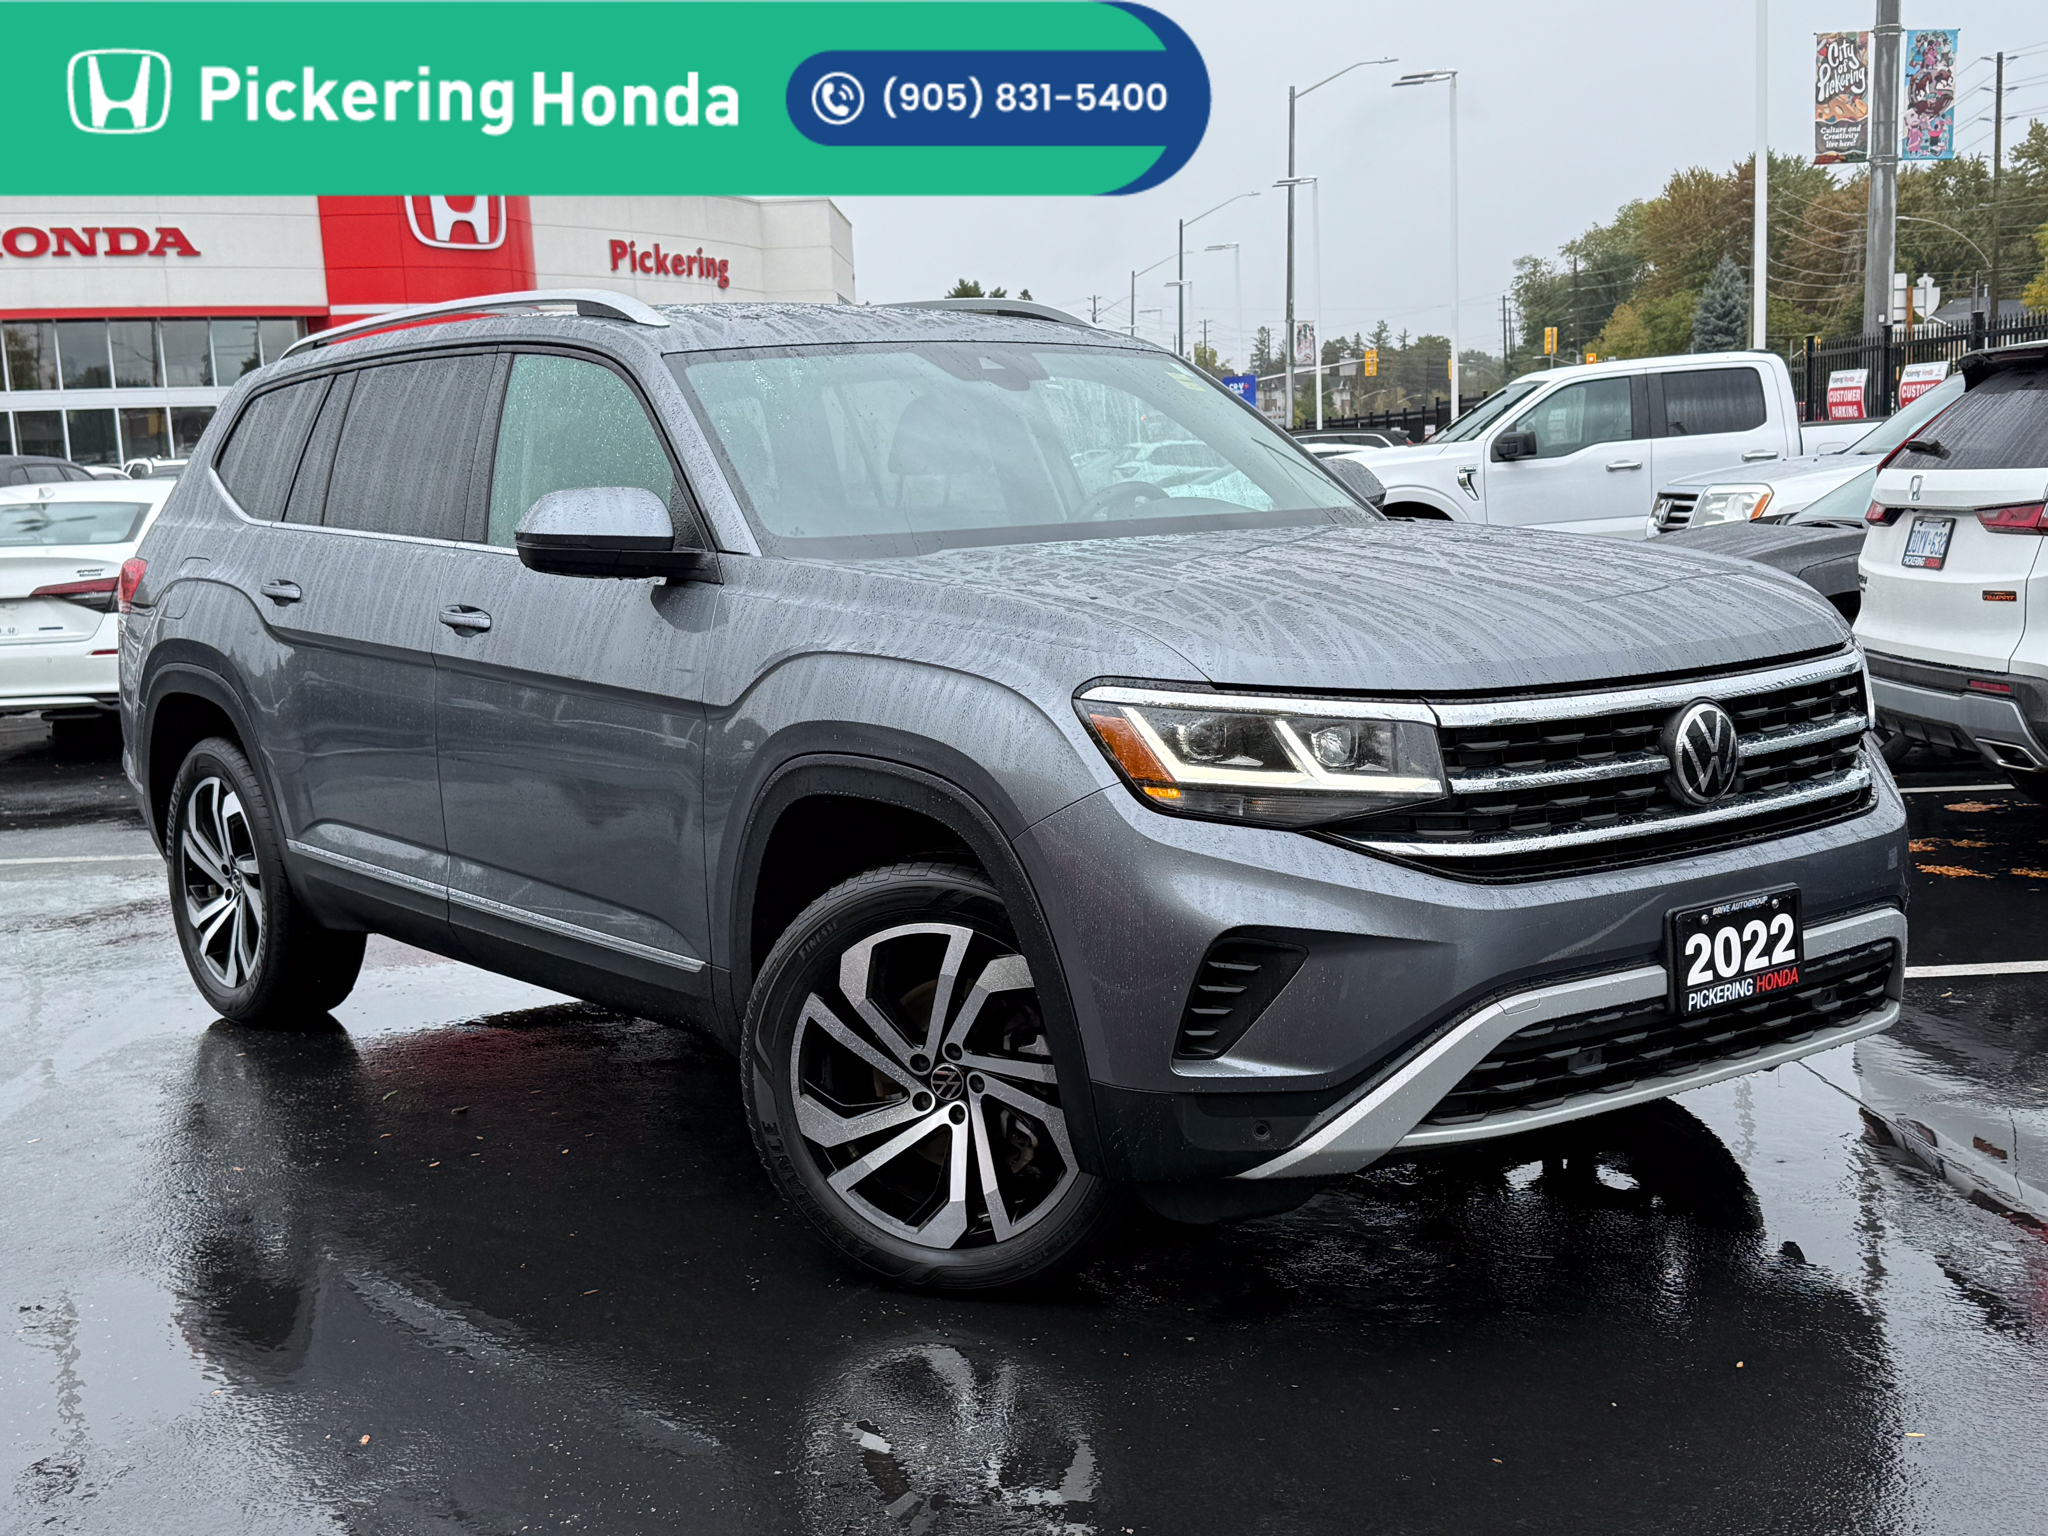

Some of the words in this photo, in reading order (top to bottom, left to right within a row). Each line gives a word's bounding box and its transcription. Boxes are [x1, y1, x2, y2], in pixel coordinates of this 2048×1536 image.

[1827, 39, 1860, 70] City
[1837, 59, 1849, 74] of
[1817, 63, 1866, 102] Pickering
[1820, 126, 1847, 135] Culture
[1848, 124, 1861, 132] and
[1823, 132, 1859, 140] Creativity
[1826, 140, 1838, 148] live
[1839, 139, 1856, 147] here!
[0, 226, 201, 258] ONDA
[609, 239, 730, 289] Pickering
[1828, 388, 1861, 403] CUSTOMER
[1831, 405, 1859, 418] PARKING
[1712, 904, 1731, 916] DRIVE
[1730, 895, 1769, 912] AUTOGROUP
[798, 918, 840, 961] FINESSE
[1685, 913, 1796, 987] 2022
[1688, 978, 1754, 1012] PICKERING
[1756, 967, 1799, 994] HONDA
